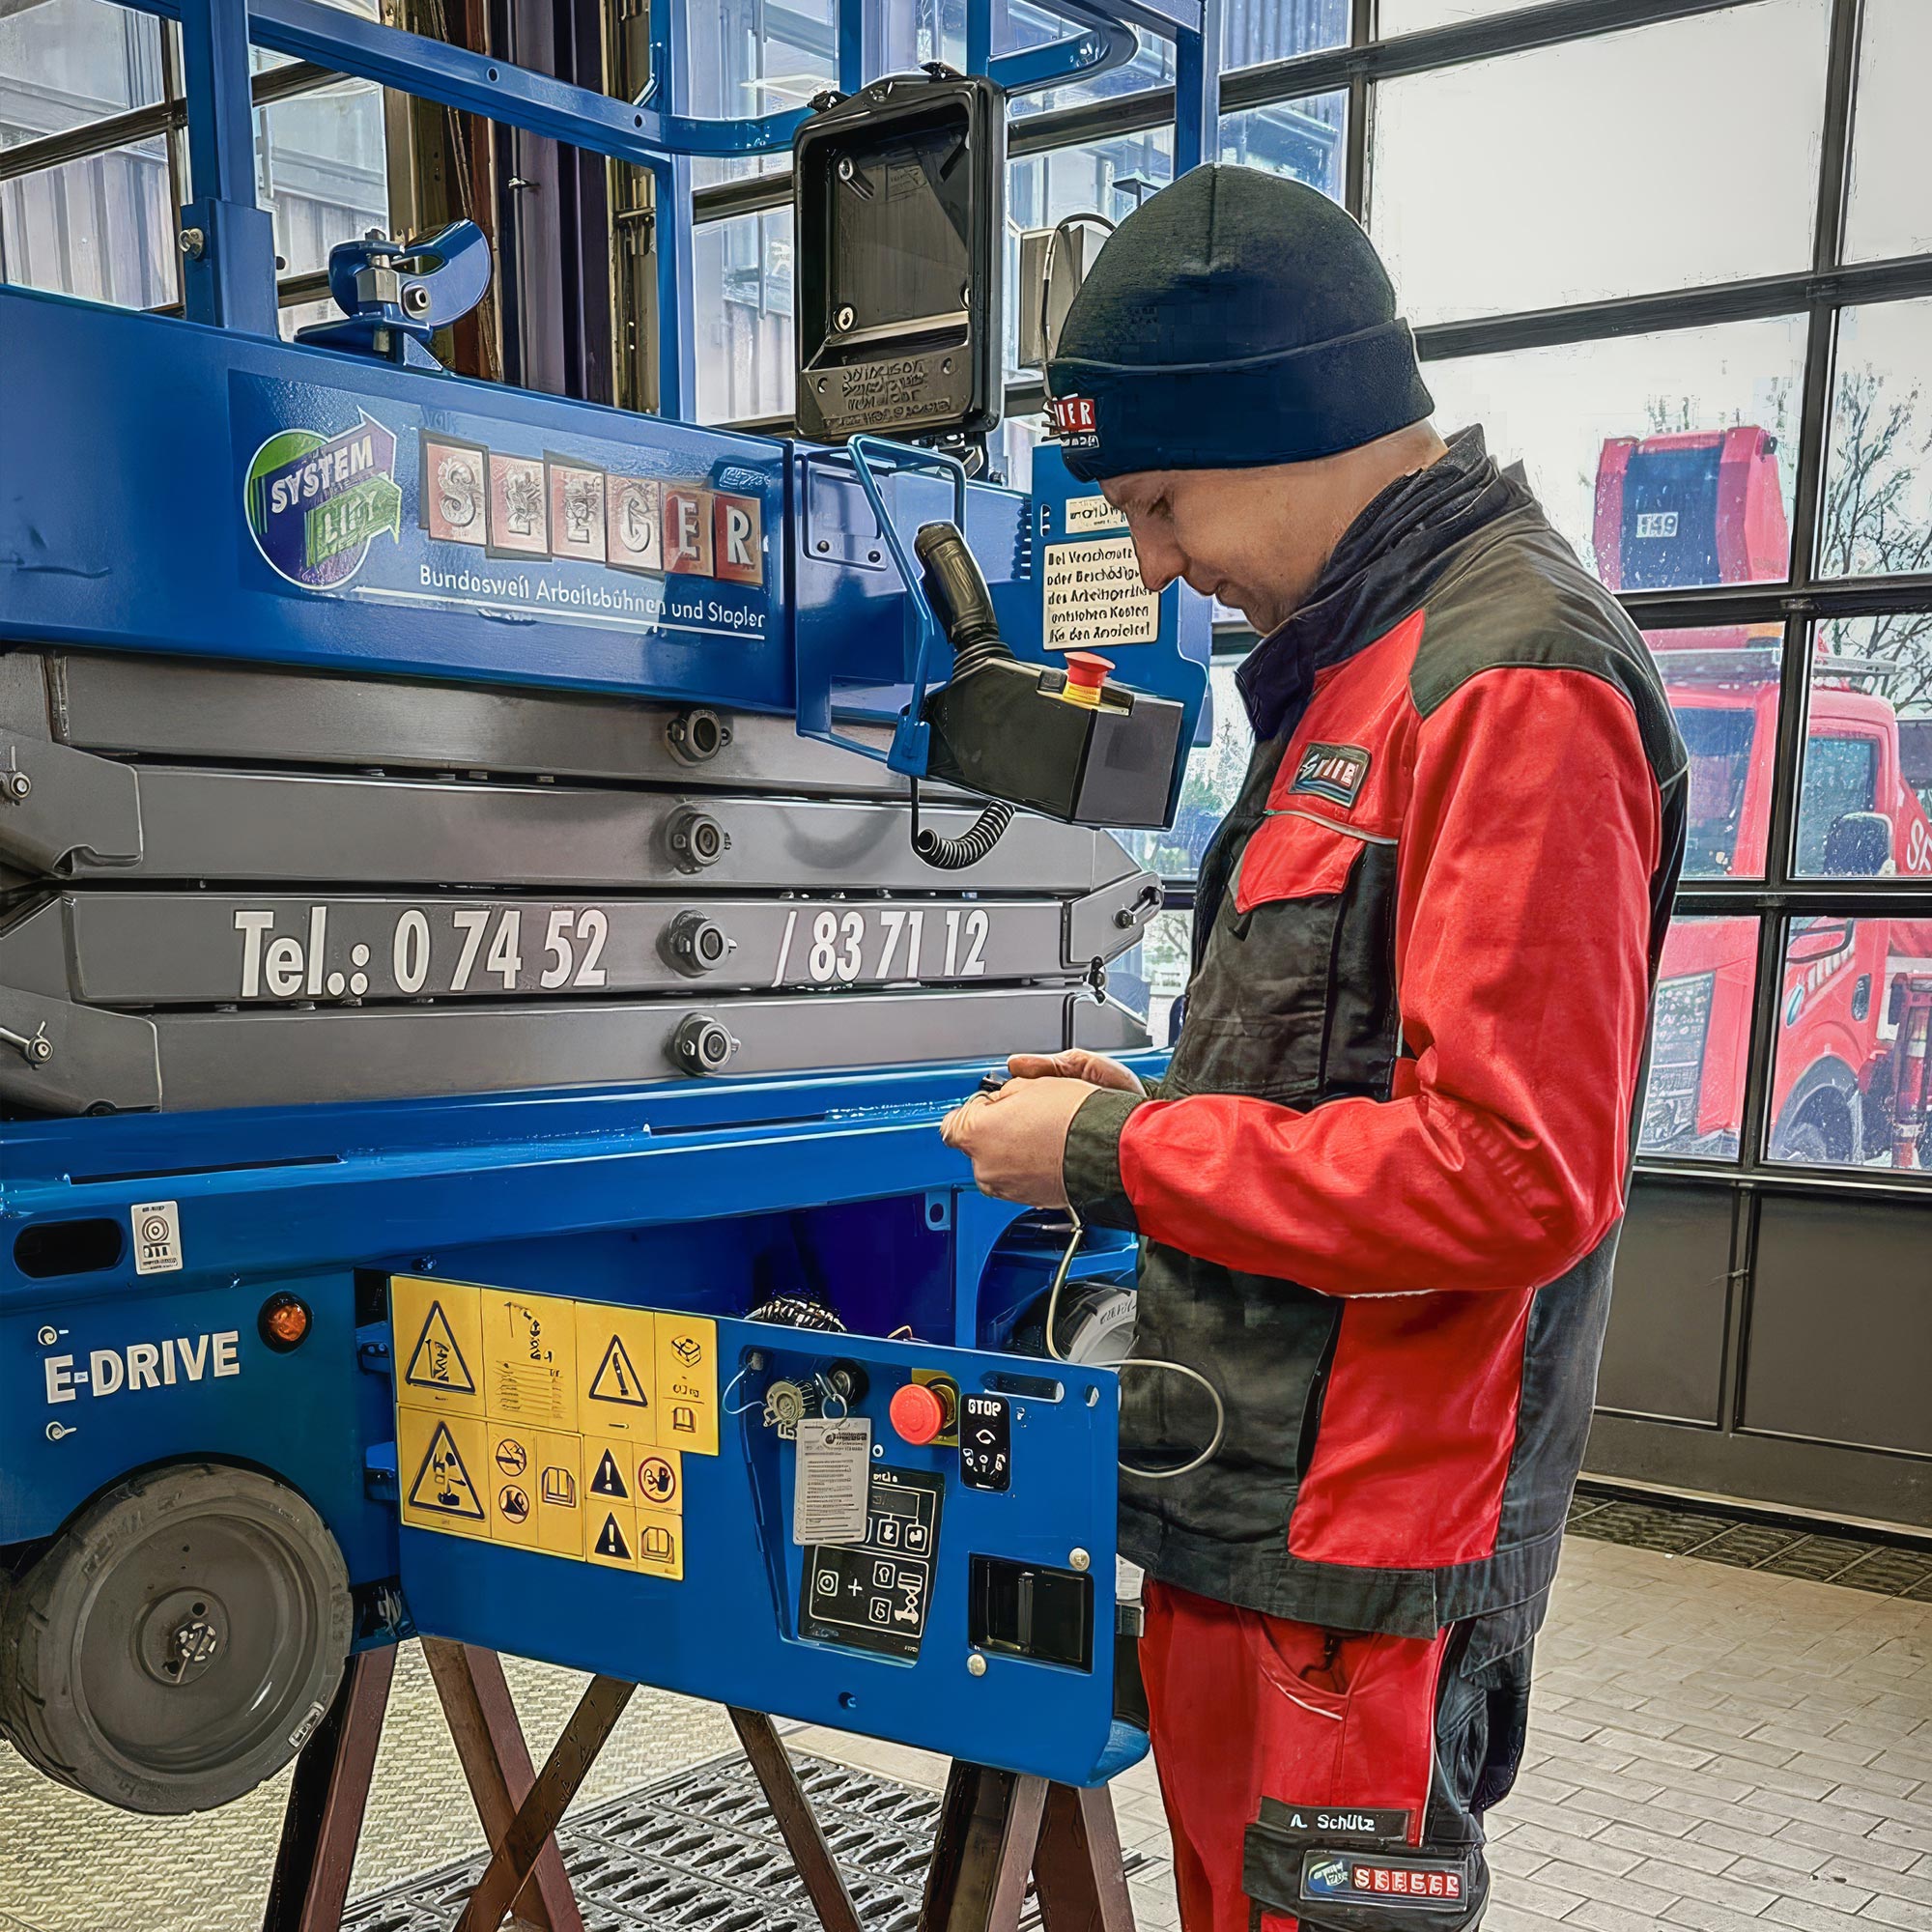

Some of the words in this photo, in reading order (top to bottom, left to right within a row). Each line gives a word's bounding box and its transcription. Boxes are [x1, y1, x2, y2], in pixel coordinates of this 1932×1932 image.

[270, 435, 375, 514] SYSTEM
[671, 600, 703, 620] und
[235, 906, 371, 997] Tel.:
[393, 909, 431, 994] 0
[449, 909, 522, 992] 74
[540, 909, 609, 989] 52
[809, 911, 866, 982] 83
[875, 911, 924, 980] 71
[944, 909, 989, 977] 12
[44, 1330, 241, 1404] E-DRIVE
